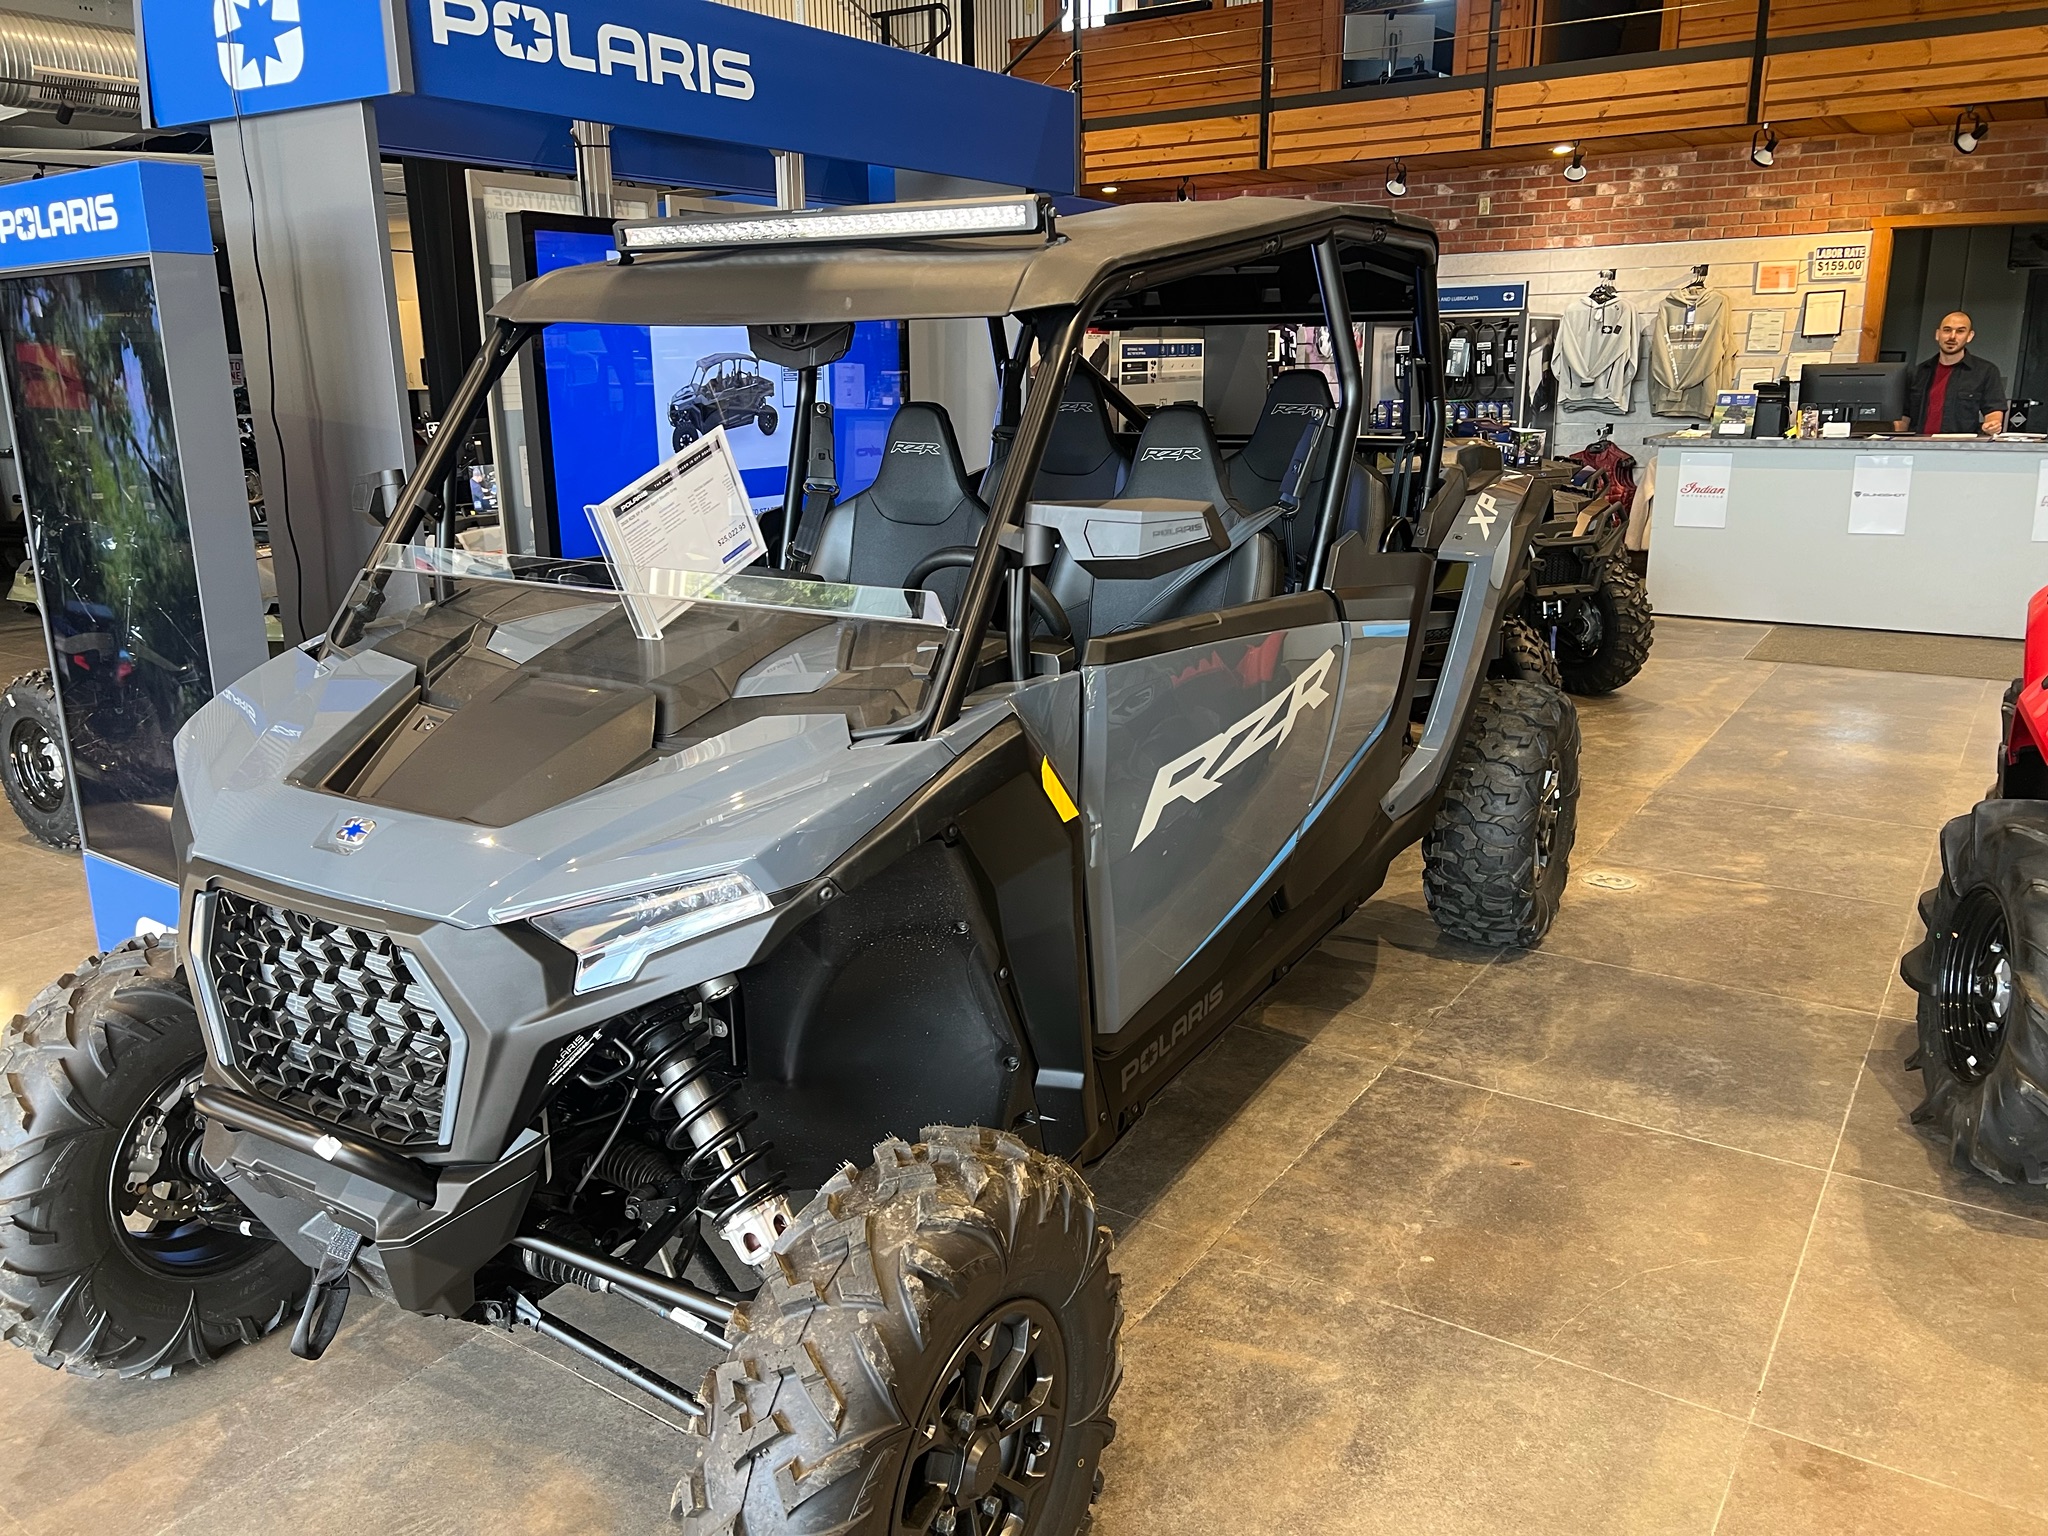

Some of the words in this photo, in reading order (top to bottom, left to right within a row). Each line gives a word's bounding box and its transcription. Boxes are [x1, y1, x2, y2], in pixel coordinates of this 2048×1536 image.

[430, 0, 755, 101] POLARIS
[0, 193, 119, 244] POLARIS
[1816, 248, 1843, 259] LABOR
[1843, 247, 1866, 258] RATE
[1817, 260, 1862, 272] $159.00
[1059, 401, 1093, 413] ZR
[890, 440, 941, 456] RZR
[1141, 447, 1202, 462] RZR
[1680, 482, 1726, 495] Indian
[620, 490, 648, 512] POLARIS
[1467, 492, 1499, 542] XP
[717, 521, 747, 547] $25,022.95
[1152, 522, 1203, 539] POLARIS
[1130, 648, 1336, 853] RZR
[1121, 980, 1224, 1094] POLARIS
